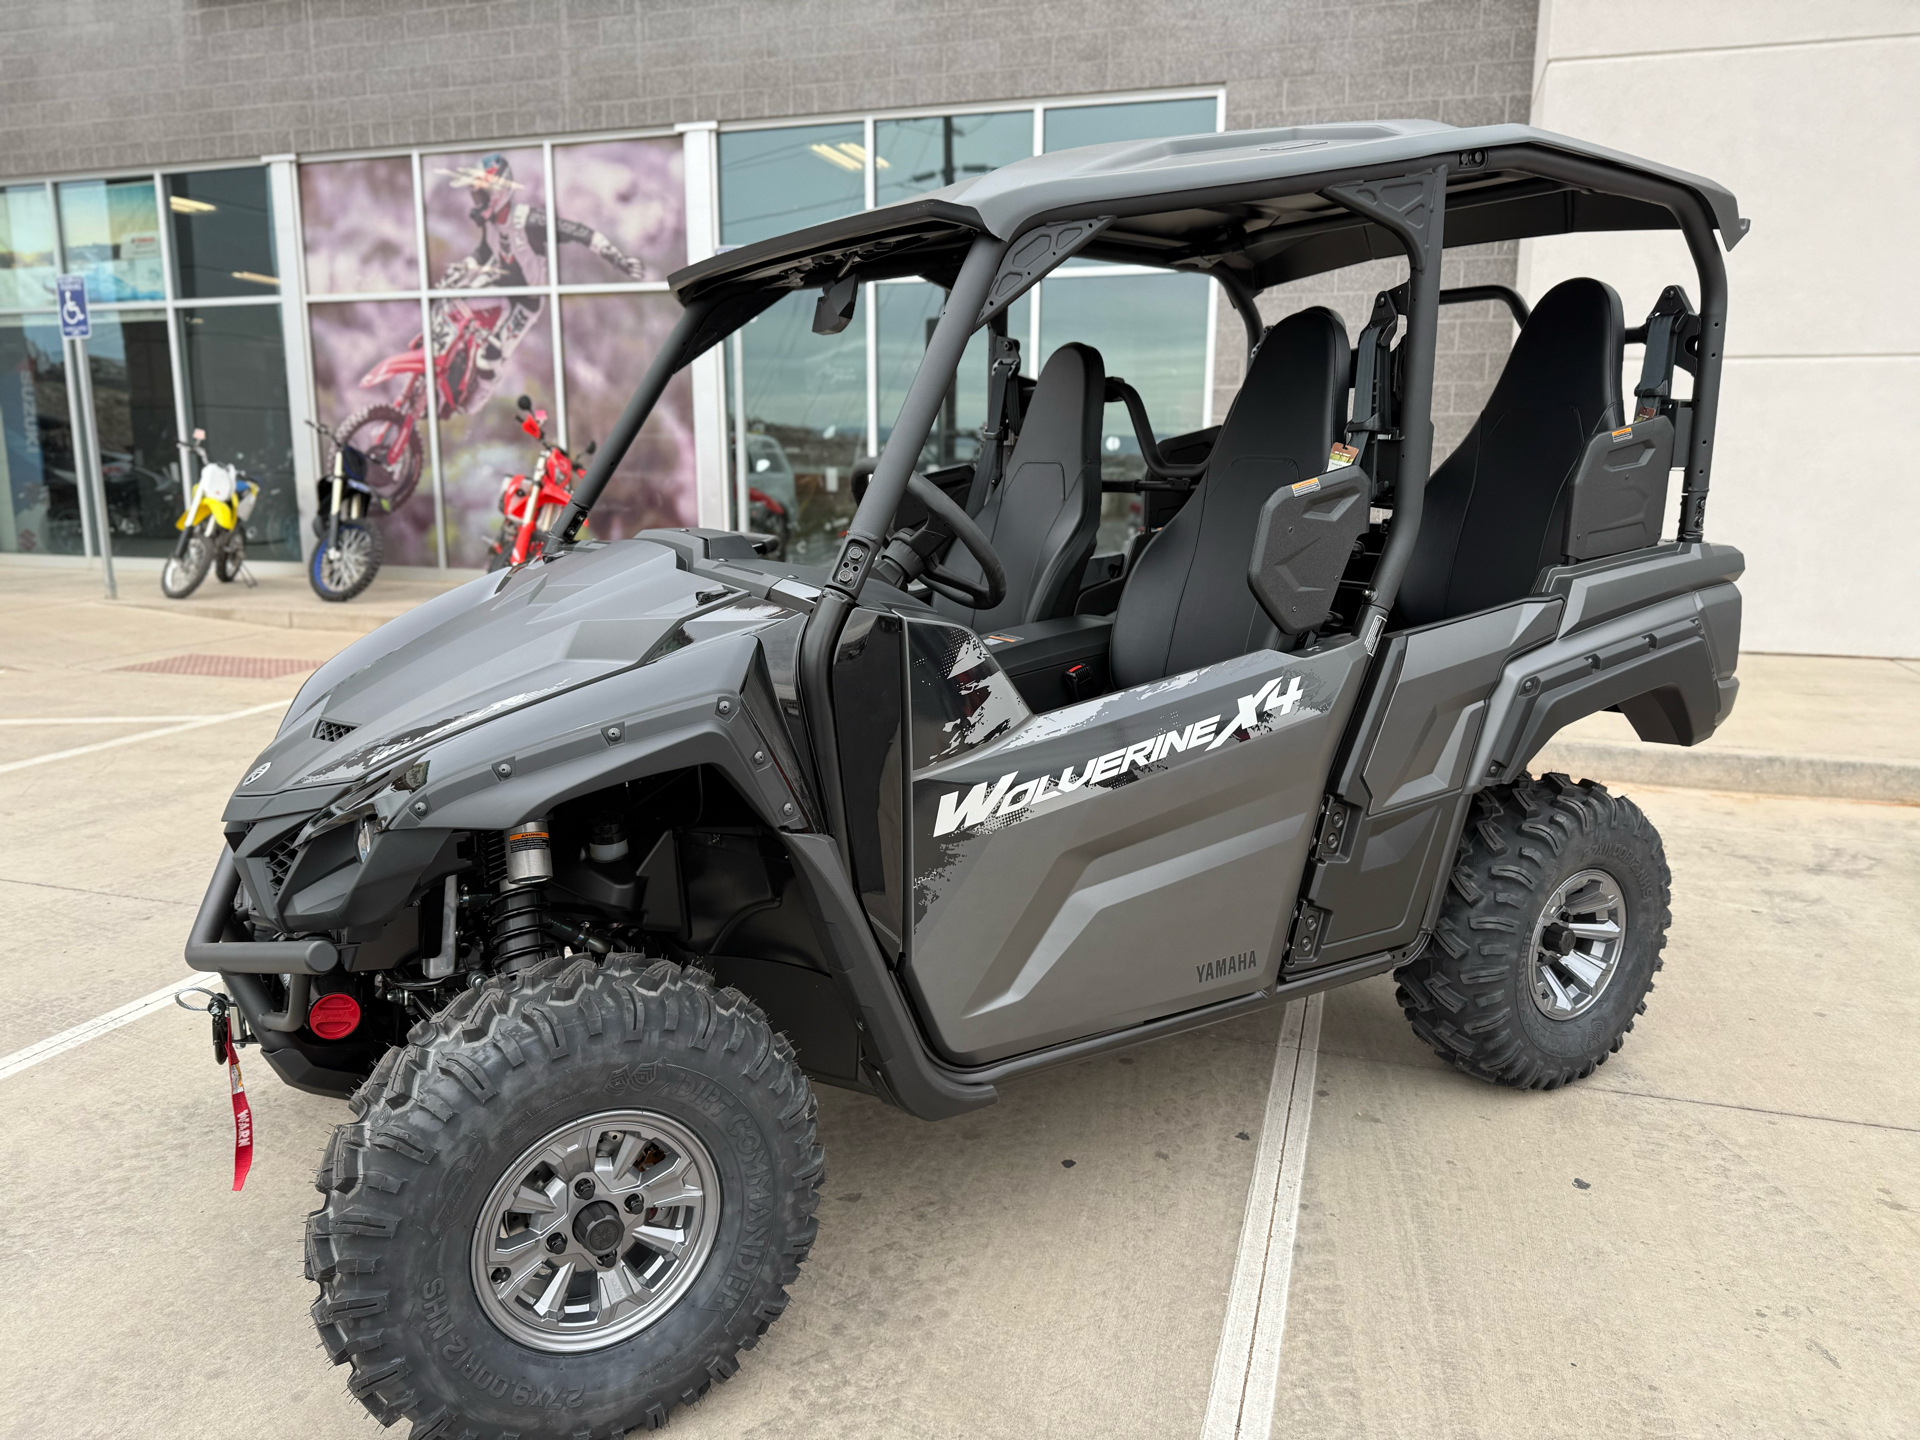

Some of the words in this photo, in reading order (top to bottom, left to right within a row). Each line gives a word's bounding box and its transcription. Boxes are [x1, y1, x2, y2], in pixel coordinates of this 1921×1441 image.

[19, 370, 39, 453] SUZUKI
[932, 713, 1222, 838] WOLVERINE
[1204, 675, 1304, 752] X4
[1635, 867, 1653, 900] NHS
[1195, 949, 1257, 984] YAMAHA
[236, 1108, 251, 1148] WARN
[669, 1072, 736, 1117] DIRT
[715, 1113, 774, 1311] COMMANDER
[422, 1277, 455, 1341] NHS
